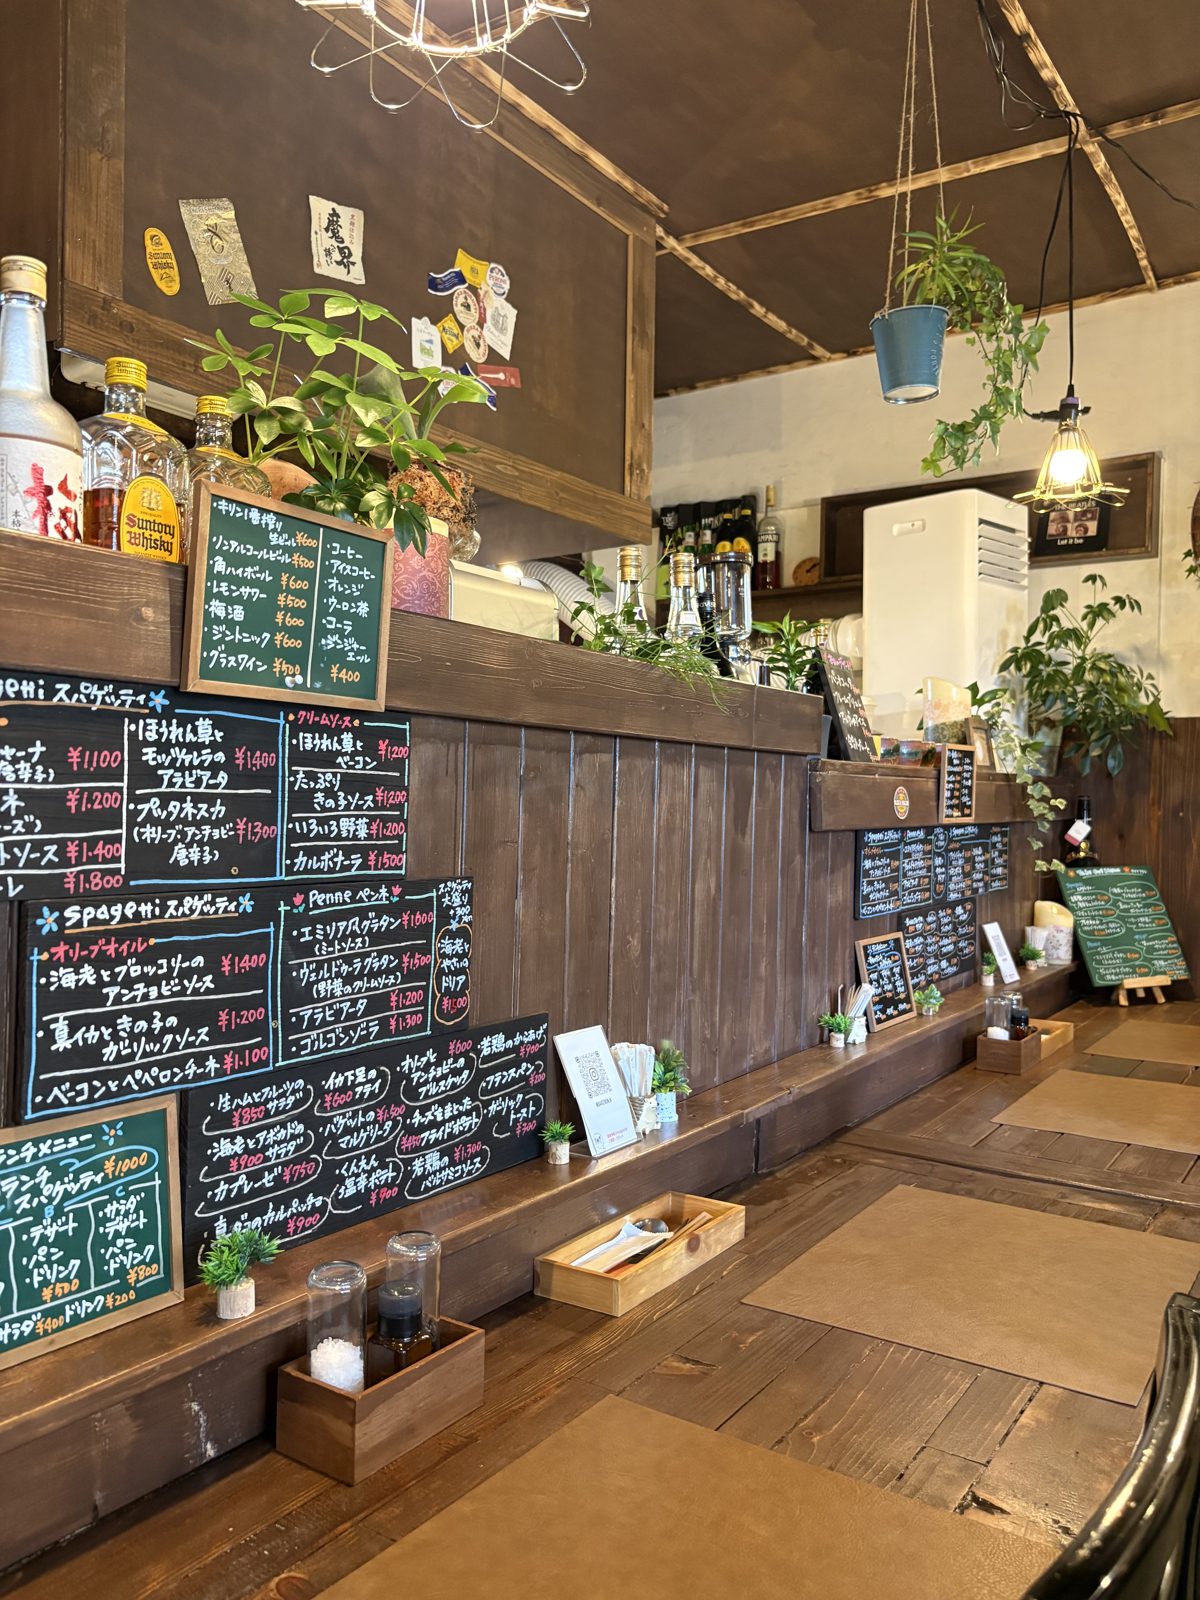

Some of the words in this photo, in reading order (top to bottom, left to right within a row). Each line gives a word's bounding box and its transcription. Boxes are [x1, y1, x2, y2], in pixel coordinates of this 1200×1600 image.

[323, 207, 357, 277] 魔界
[147, 251, 173, 261] Suntory
[150, 260, 175, 271] Whisky
[125, 512, 176, 540] Suntory
[268, 532, 297, 548] 生ビール
[296, 530, 318, 548] ¥600
[126, 530, 174, 557] Whisky
[331, 542, 364, 560] コーヒー
[213, 555, 273, 584] 角ハイボール
[280, 572, 309, 591] ¥600
[291, 552, 315, 569] ¥500
[330, 558, 376, 580] アイスコーヒー
[212, 581, 267, 602] レモンサワー
[276, 592, 307, 609] ¥500
[328, 577, 364, 597] オレンジ
[209, 599, 245, 622] 梅酒
[275, 610, 305, 627] ¥600
[327, 595, 371, 619] ウーロン茶
[211, 624, 271, 649] ジントニック
[273, 631, 303, 649] ¥600
[325, 616, 353, 635] コーラ
[327, 634, 367, 652] ジンジャー
[209, 644, 268, 673] グラスワイン
[272, 657, 301, 678] ¥500
[346, 651, 372, 665] エール
[330, 664, 361, 685] ¥400
[53, 682, 147, 710] スパゲッティ
[138, 716, 225, 746] ほうれん草と
[297, 710, 352, 732] クリームソース
[299, 732, 364, 757] ほうれん草と
[336, 755, 378, 770] ベーコン
[157, 769, 229, 793] アラビアータ
[294, 770, 342, 792] たっぷり
[136, 795, 226, 824] プッタネスカ
[313, 792, 381, 812] きの子ソース
[295, 817, 370, 844] いろいろ野菜
[168, 842, 220, 868] 唐辛子)
[293, 848, 363, 873] カルボナーラ
[308, 889, 353, 908] Penne
[355, 884, 390, 902] ペンネ
[438, 880, 473, 895] スパゲッティ
[441, 893, 469, 908] 大盛り
[63, 898, 161, 928] Spagetti
[166, 893, 239, 920] スパゲッティ
[300, 911, 402, 943] エミリア風グラタン
[49, 936, 149, 963] オリーブオイル
[314, 935, 370, 957] (ミートソース)
[438, 936, 470, 956] 海老と
[48, 953, 205, 991] 海老とブロッコリーの
[440, 959, 469, 973] やさいの
[102, 975, 216, 1007] アンチョビーソース
[312, 971, 402, 999] (野菜のクリームソース)
[441, 975, 466, 993] ドリア
[299, 998, 368, 1029] アラビアータ
[48, 1010, 178, 1053] 真イカときの子の
[101, 1026, 210, 1062] ガーリックソース
[300, 1020, 380, 1055] ゴルゴンゾーラ
[480, 1023, 548, 1058] 若鶏のからあげ
[401, 1048, 438, 1074] オリーブと
[448, 1039, 473, 1056] ¥600
[519, 1043, 540, 1059] ¥900
[46, 1054, 221, 1104] ベーコンとペペロンチーネ
[324, 1065, 377, 1091] イカ下足の
[410, 1057, 466, 1086] アンチョビーの
[418, 1069, 470, 1100] ブルスケッタ
[217, 1078, 305, 1113] 生ハムとフルーツの
[324, 1089, 354, 1111] ¥600
[355, 1079, 382, 1100] フライ
[487, 1093, 524, 1119] ガーリック
[232, 1105, 266, 1128] ¥850
[266, 1090, 304, 1115] サラダ
[324, 1108, 376, 1137] バゲットの
[411, 1096, 473, 1128] チーズをまとった
[509, 1100, 537, 1127] トースト
[212, 1120, 305, 1162] 海老とアボカドの
[337, 1120, 393, 1150] マルゲリータ
[421, 1111, 480, 1147] フライドポテト
[229, 1153, 265, 1172] ¥900
[265, 1136, 304, 1163] サラダ
[341, 1153, 380, 1178] くんえん
[411, 1150, 450, 1179] 若鶏の
[1, 1165, 53, 1200] ランチ
[214, 1165, 282, 1203] カプレーゼ
[282, 1162, 316, 1184] ¥750
[420, 1156, 482, 1192] バルサミコソース
[14, 1170, 105, 1215] スパゲッティ
[115, 1185, 127, 1198] C
[369, 1186, 399, 1208] ¥900
[44, 1204, 55, 1220] B
[103, 1191, 146, 1220] サラダ
[29, 1212, 79, 1247] デザート
[104, 1209, 148, 1241] デザート
[286, 1213, 320, 1237] ¥900
[28, 1245, 65, 1270] パン
[104, 1238, 138, 1260] パン
[109, 1244, 155, 1277] ドリンク
[32, 1259, 81, 1289] ドリンク
[126, 1262, 159, 1288] ¥800
[41, 1278, 80, 1303] ¥500
[0, 1311, 42, 1345] サラダ
[35, 1313, 66, 1337] ¥400
[65, 1295, 105, 1324] ドリンク
[105, 1290, 136, 1310] ¥200
